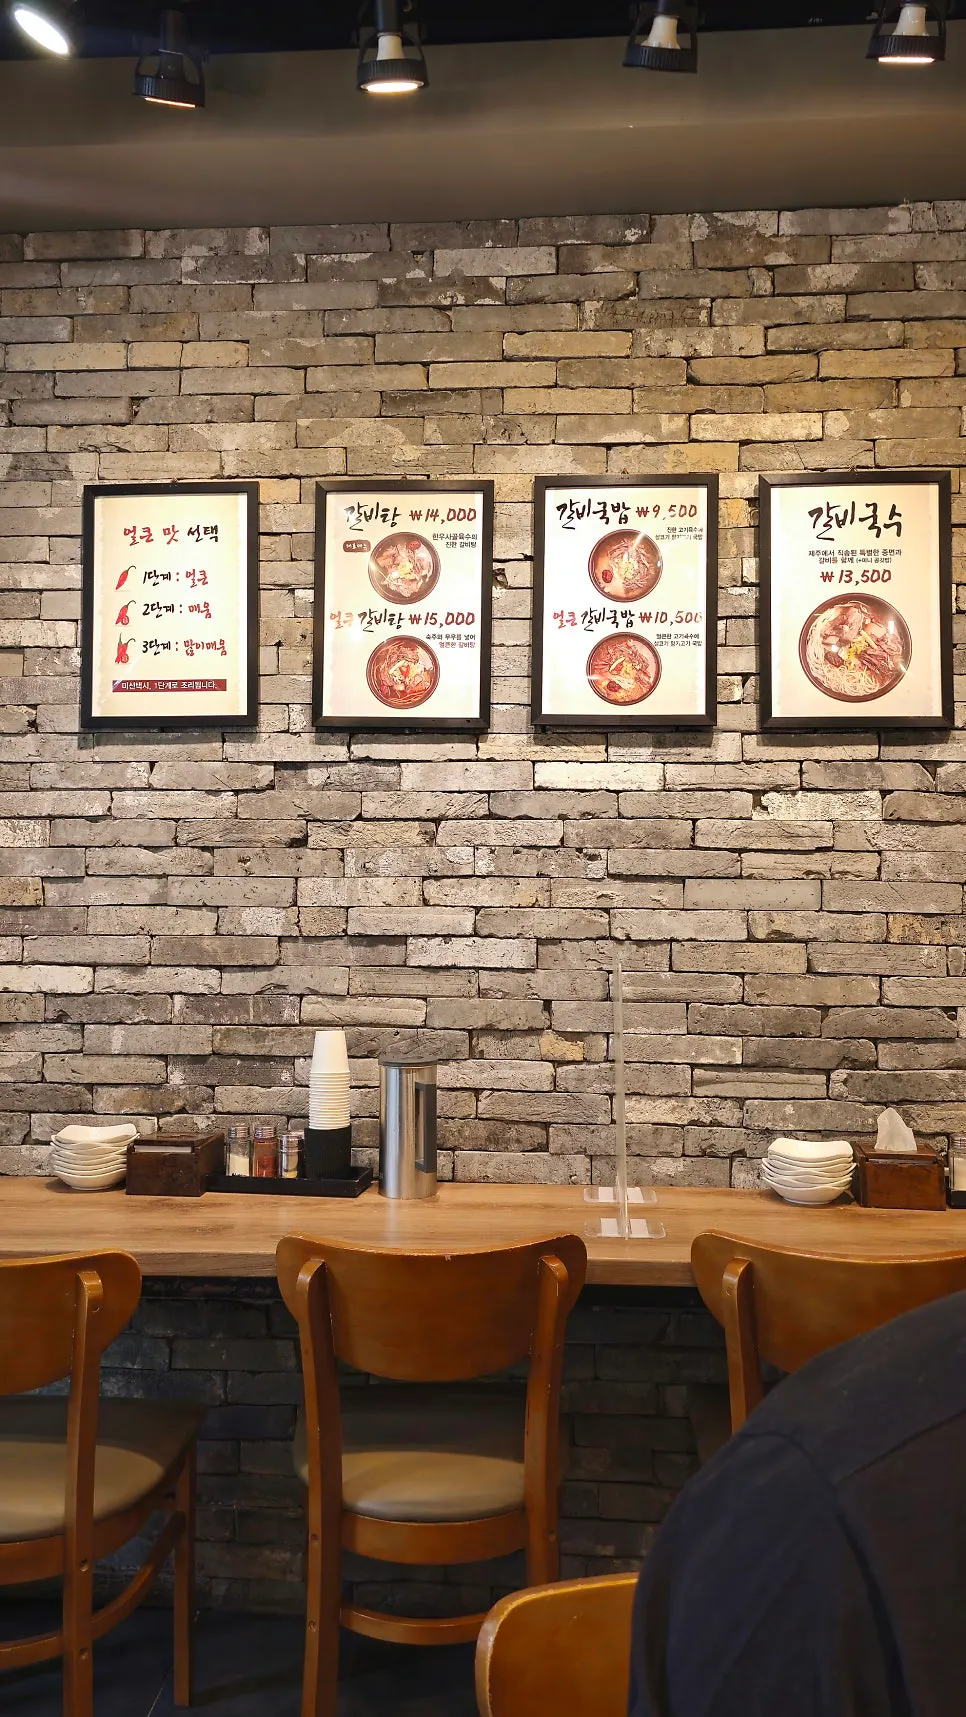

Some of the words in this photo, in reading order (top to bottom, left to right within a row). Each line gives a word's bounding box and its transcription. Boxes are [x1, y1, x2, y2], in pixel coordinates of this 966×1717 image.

[343, 501, 402, 531] 갈비탕
[409, 508, 477, 525] ₩14,000
[556, 498, 631, 530] 갈비국밥
[808, 501, 902, 541] 갈비국수
[123, 524, 154, 546] 얼큰
[163, 524, 180, 545] 맛
[187, 524, 219, 543] 선택
[808, 549, 835, 557] 제주에서
[837, 549, 857, 557] 직송된
[818, 556, 838, 564] 갈비를
[142, 570, 171, 586] 1단계
[185, 569, 209, 588] 얼큰
[142, 602, 175, 619] 2단계
[188, 601, 212, 619] 매움
[552, 610, 578, 630] 얼큰
[581, 607, 634, 632] 갈비국밥
[357, 608, 406, 633] 갈비탕
[408, 611, 475, 629] ₩15,000
[142, 639, 171, 656] 3단계
[458, 641, 476, 649] 갈비탕
[181, 680, 218, 690] 조리됩니다.
